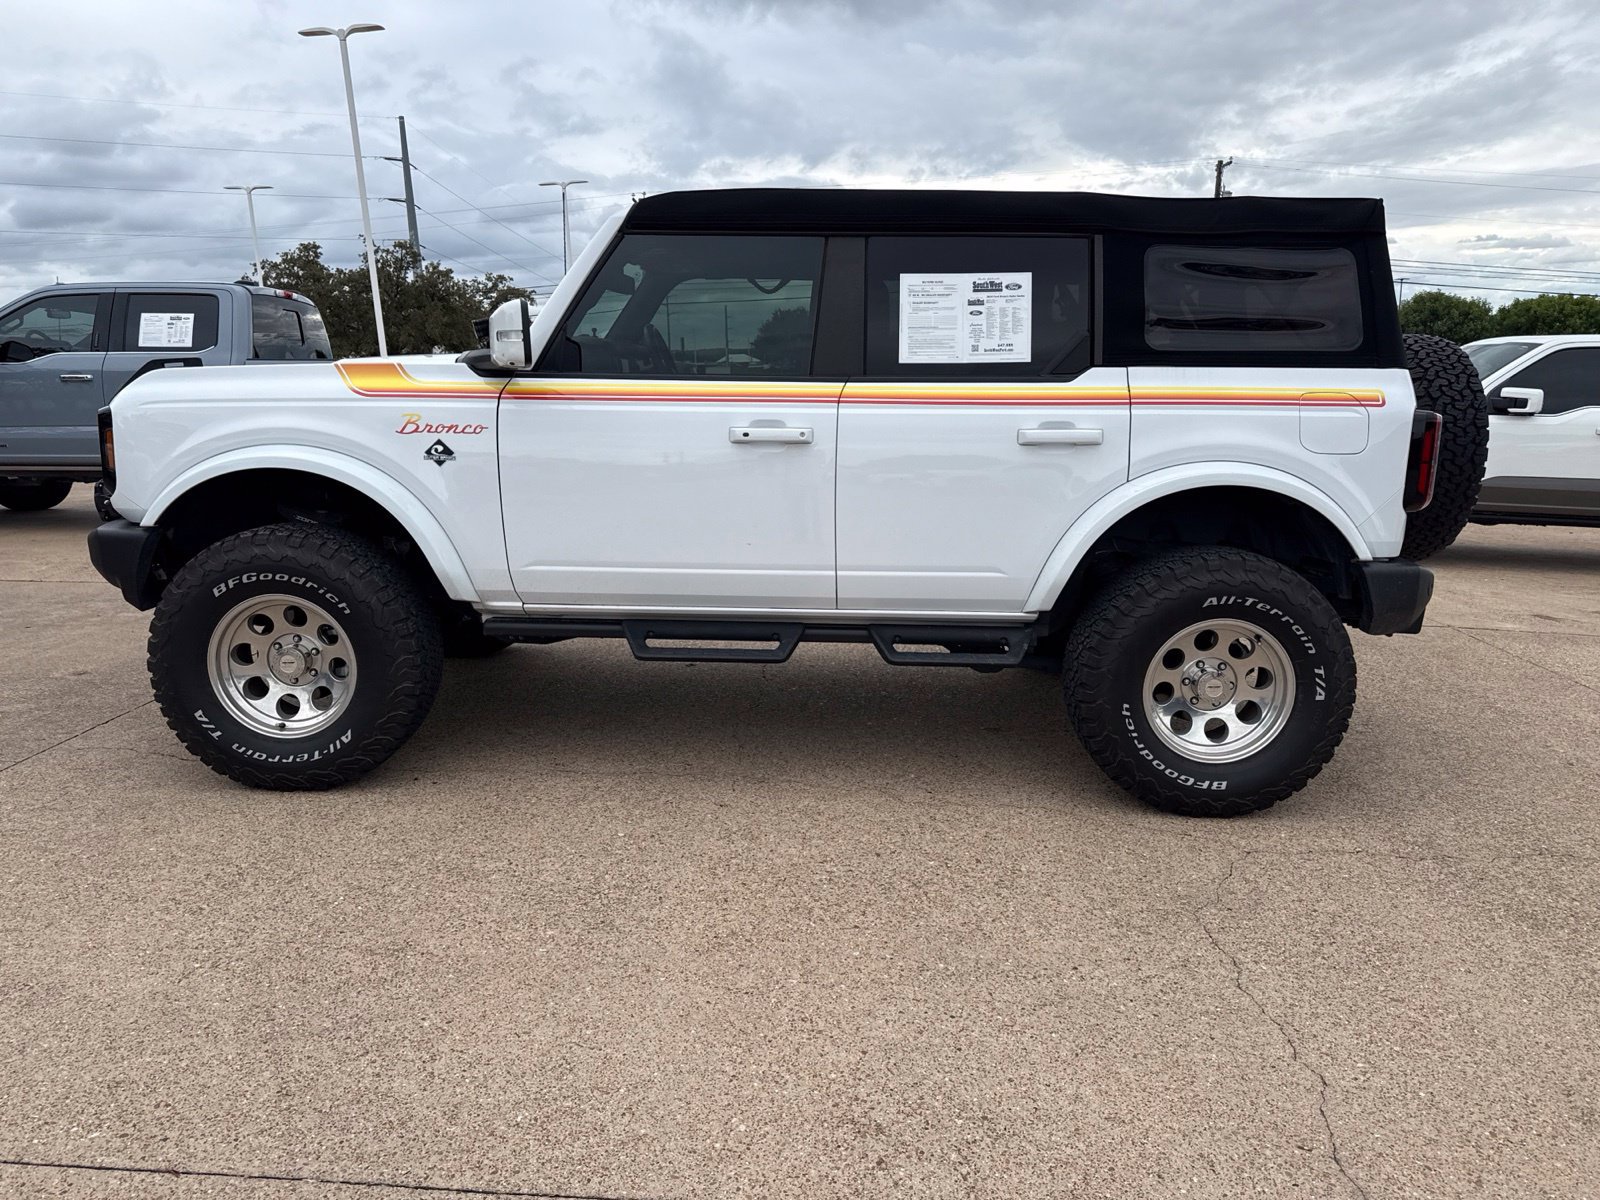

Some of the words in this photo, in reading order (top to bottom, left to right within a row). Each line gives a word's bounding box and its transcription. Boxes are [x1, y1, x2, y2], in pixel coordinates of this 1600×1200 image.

[395, 412, 489, 435] Bronco
[211, 572, 351, 615] BFGoodrich
[1202, 596, 1316, 654] All-Terrain
[1313, 665, 1327, 701] T/A
[193, 709, 223, 741] T/A
[231, 729, 353, 763] All-Terrain
[1120, 703, 1228, 791] BFGoodrich
